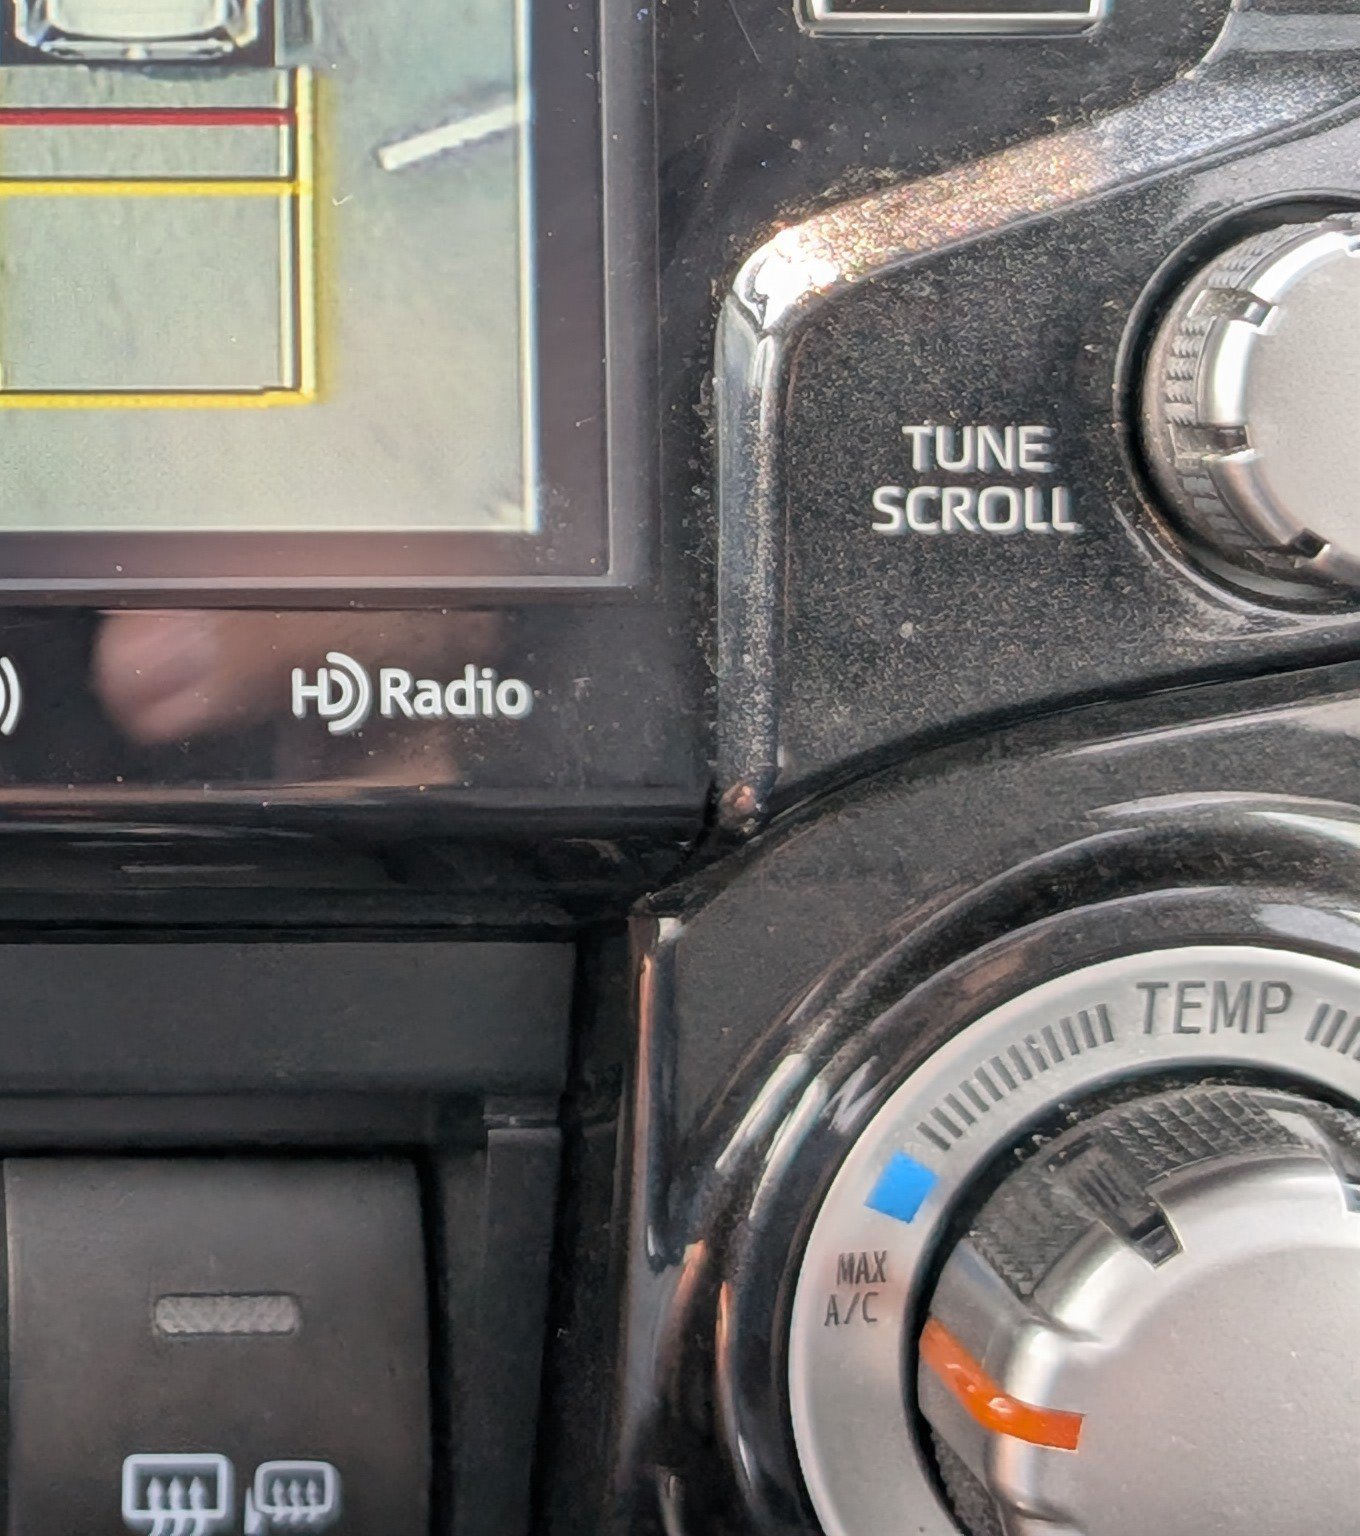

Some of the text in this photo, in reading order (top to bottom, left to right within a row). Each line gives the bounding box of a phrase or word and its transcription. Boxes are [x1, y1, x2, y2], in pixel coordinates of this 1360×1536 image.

[903, 425, 1053, 473] TUNE
[872, 485, 1080, 533] SCROLL
[291, 652, 534, 735] HD Radio
[1136, 980, 1293, 1035] TEMP
[837, 1250, 888, 1285] MAX
[824, 1291, 879, 1327] A/C
